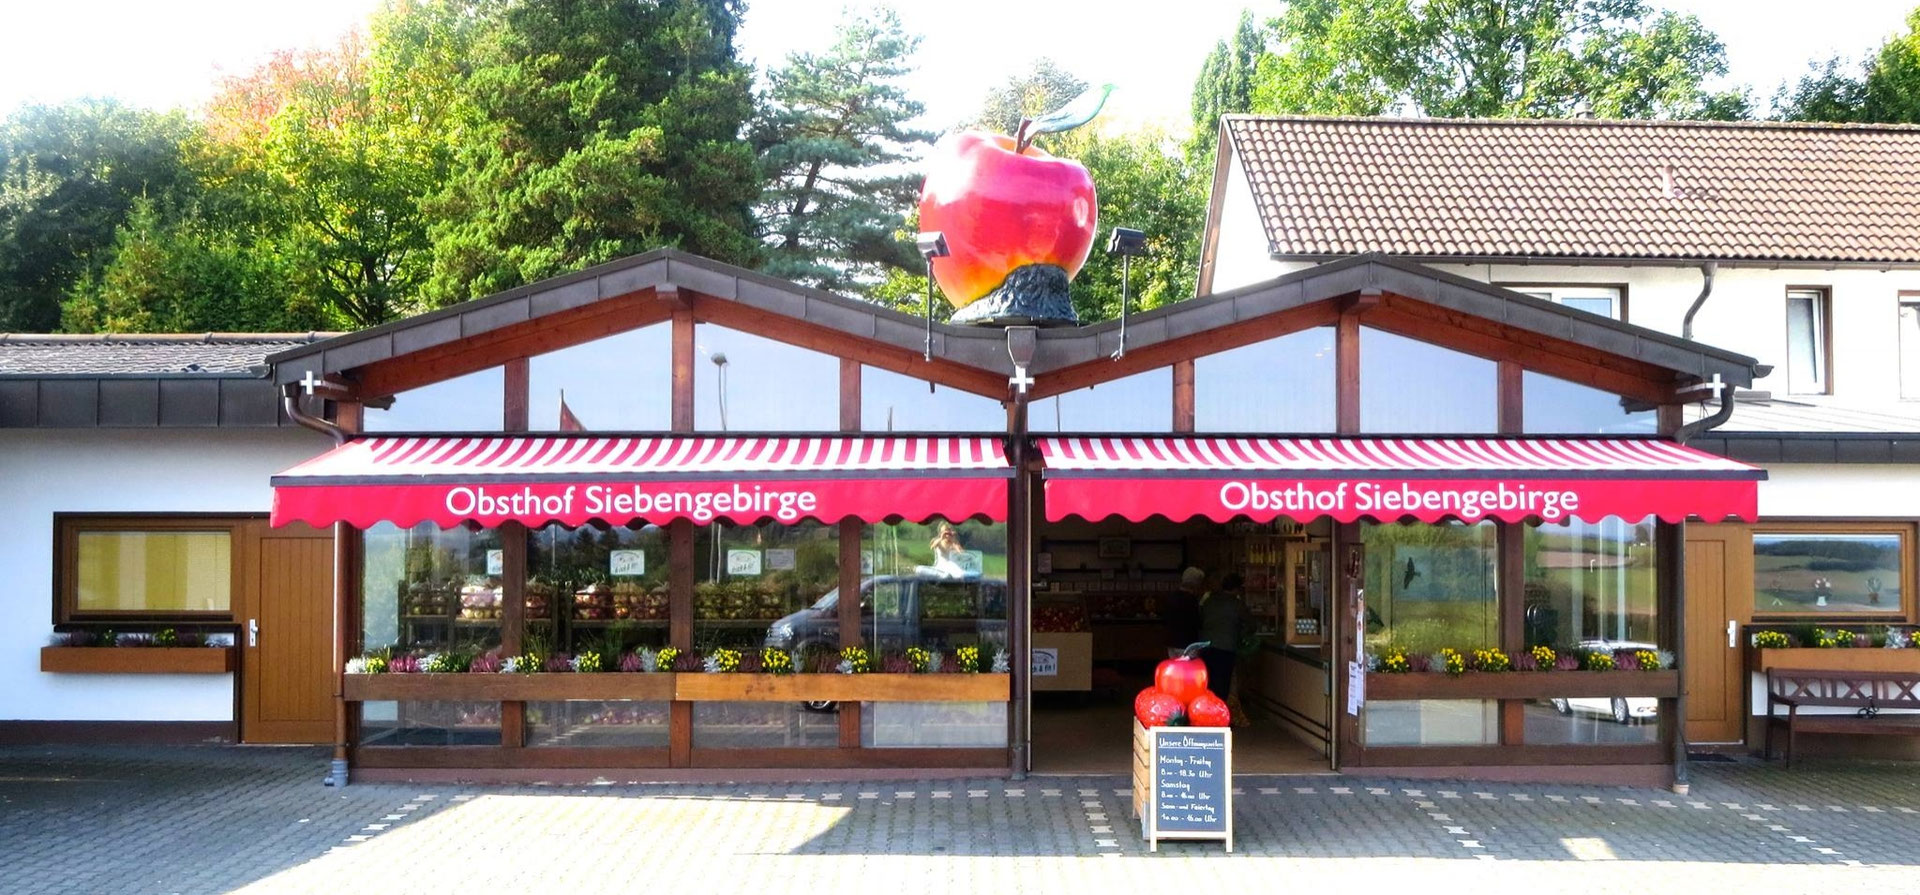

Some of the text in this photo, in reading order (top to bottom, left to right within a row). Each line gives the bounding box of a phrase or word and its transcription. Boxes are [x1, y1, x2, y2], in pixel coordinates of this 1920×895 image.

[445, 484, 817, 521] Obsthof Siebengebirge
[1219, 481, 1579, 518] Obsthof Siebengebirge
[1159, 737, 1182, 747] Unsere
[1160, 755, 1184, 766] Montag
[1189, 755, 1212, 768] Freitag
[1199, 770, 1213, 778] Uhr
[1161, 779, 1190, 792] Samstag
[1198, 792, 1211, 800] Uhr
[1190, 803, 1215, 814] Feiertag
[1204, 814, 1217, 823] Uhr
